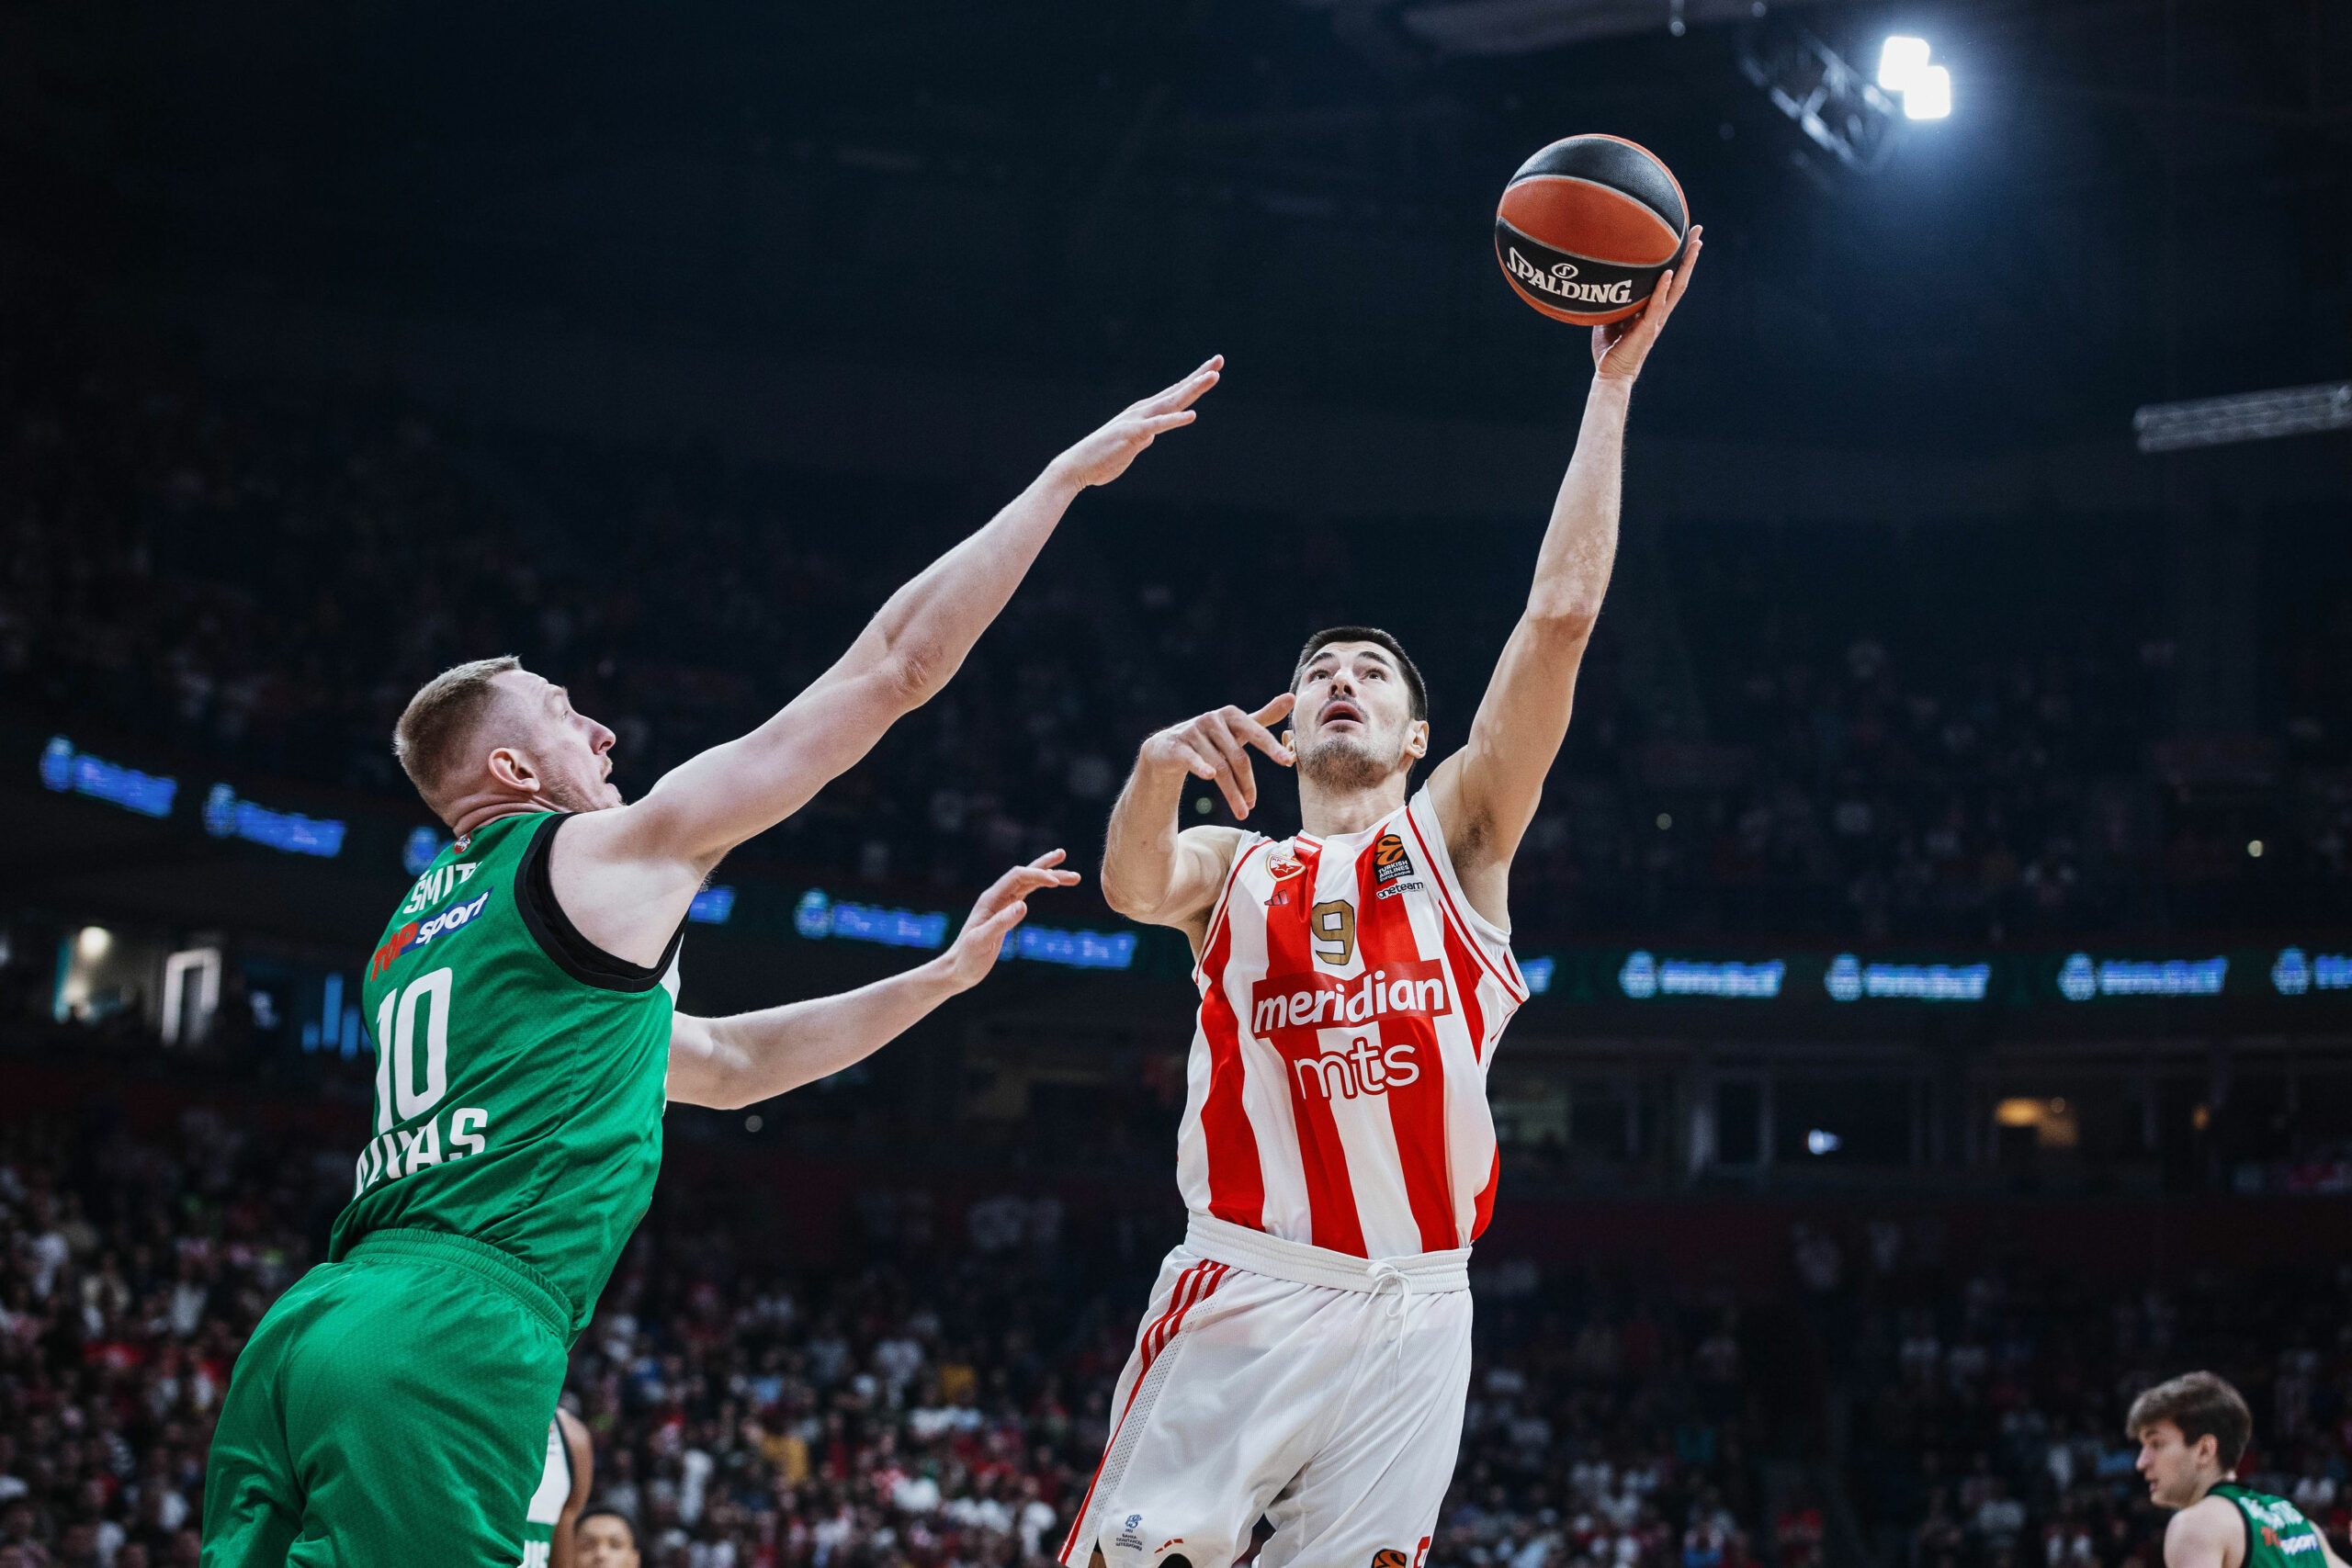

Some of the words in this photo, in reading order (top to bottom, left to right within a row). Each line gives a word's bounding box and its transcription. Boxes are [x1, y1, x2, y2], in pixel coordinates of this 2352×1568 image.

[1507, 247, 1632, 303] SPALDING
[1378, 860, 1408, 874] TURKISH
[1379, 865, 1409, 880] AIRLINES
[1312, 899, 1355, 966] 9
[1254, 970, 1444, 1033] meridian
[376, 967, 453, 1137] 10
[1295, 1040, 1419, 1100] mts
